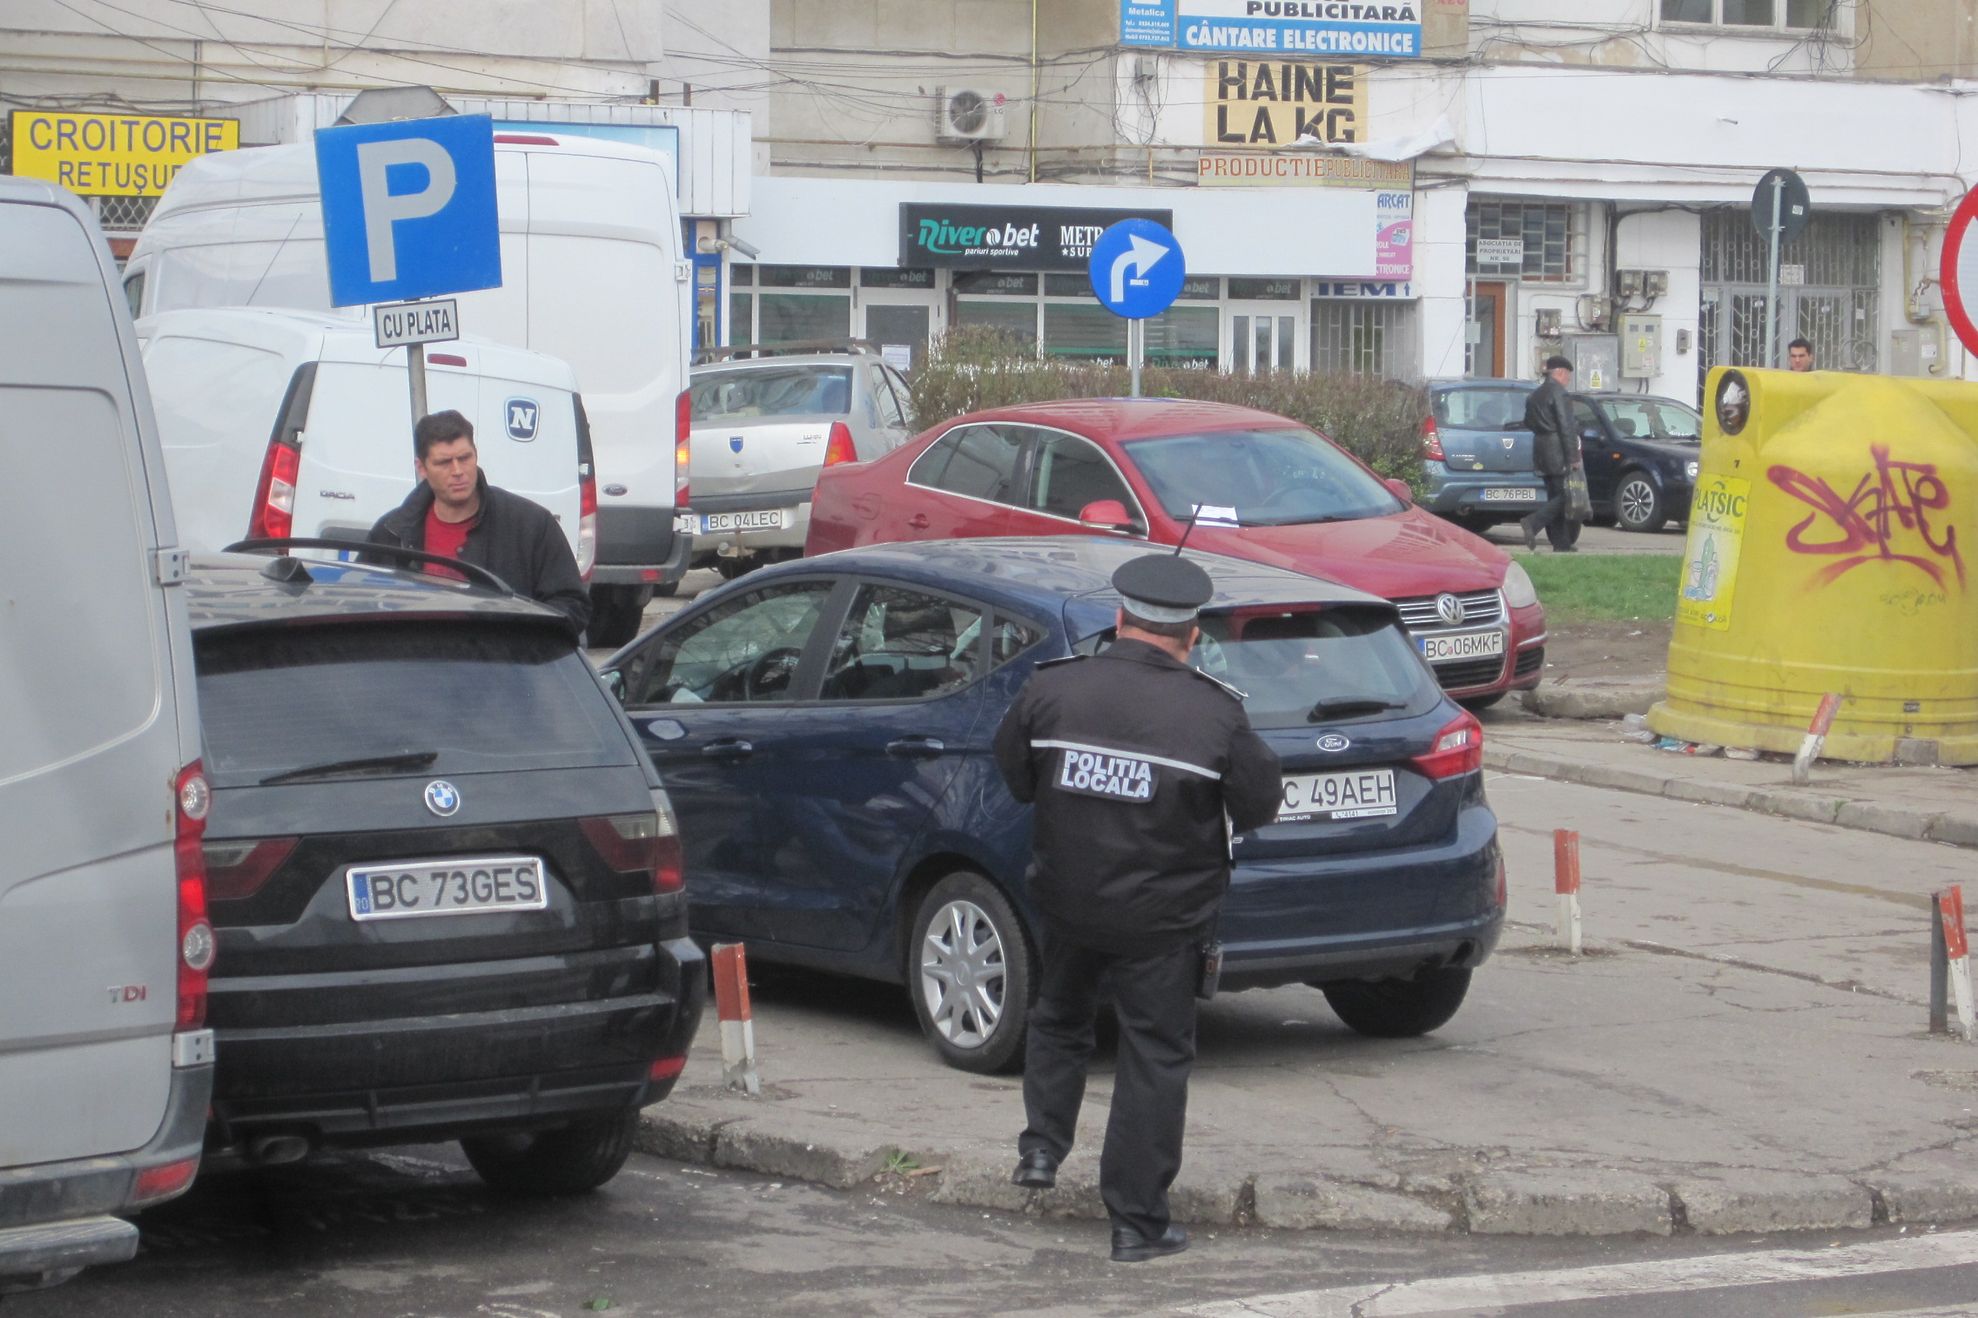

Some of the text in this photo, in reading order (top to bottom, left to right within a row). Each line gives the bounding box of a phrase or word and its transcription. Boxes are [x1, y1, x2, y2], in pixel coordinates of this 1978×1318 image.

[1186, 19, 1413, 53] CÂNTARE ELECTRONICE
[1218, 61, 1355, 104] HAINE
[30, 118, 224, 154] CROITORIE
[1217, 104, 1356, 144] LA KG
[1199, 157, 1325, 177] PRODUCTIE
[356, 137, 458, 284] P
[917, 218, 1040, 250] River bet
[964, 247, 1019, 257] pariuri sportive
[383, 308, 451, 339] CU PLATA
[709, 515, 729, 529] BC
[734, 512, 779, 528] 04LEC
[1425, 634, 1501, 658] BC 06MKF
[1283, 774, 1394, 809] C 49AEH
[370, 867, 538, 910] BC 73GES
[106, 985, 146, 1003] TDI
